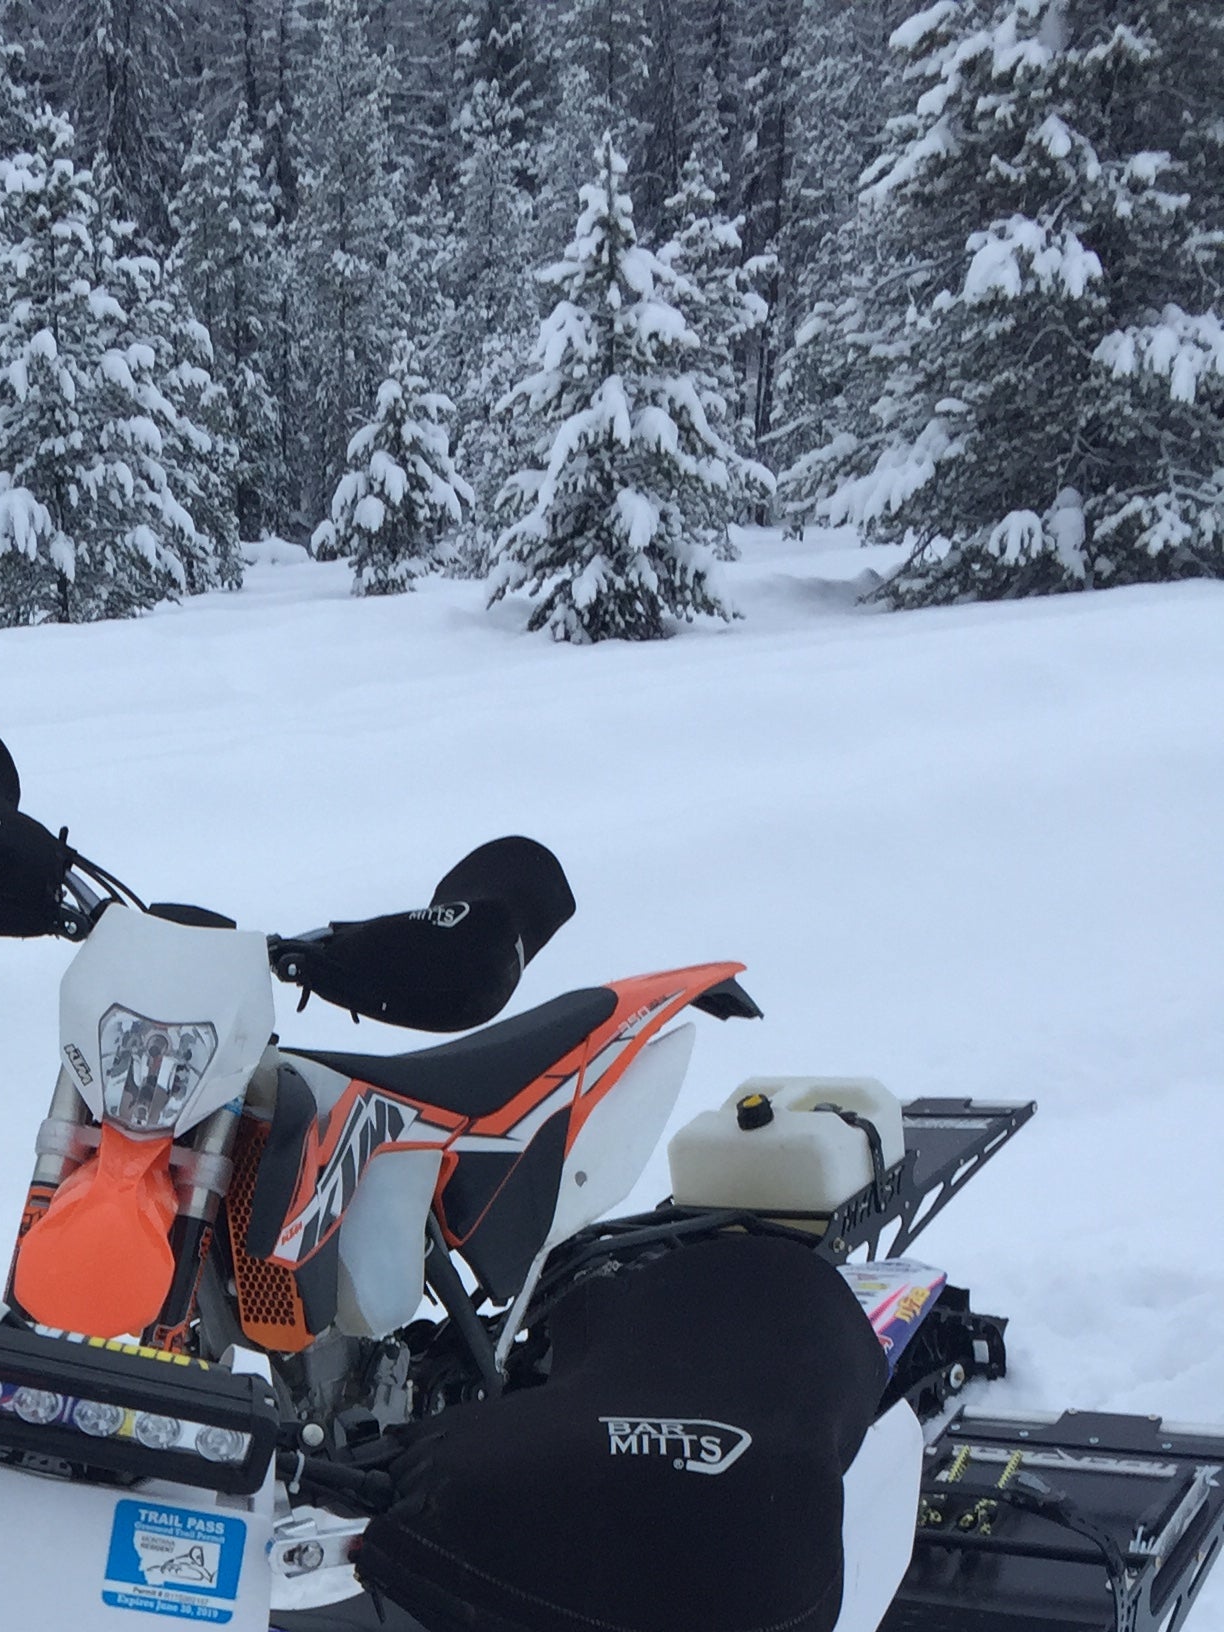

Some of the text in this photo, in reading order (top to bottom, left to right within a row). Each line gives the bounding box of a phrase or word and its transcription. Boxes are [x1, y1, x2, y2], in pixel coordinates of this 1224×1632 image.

[63, 1043, 94, 1087] KTM
[607, 1421, 685, 1436] BAR
[610, 1433, 723, 1463] MITTS
[138, 1508, 225, 1535] TRAIL PASS
